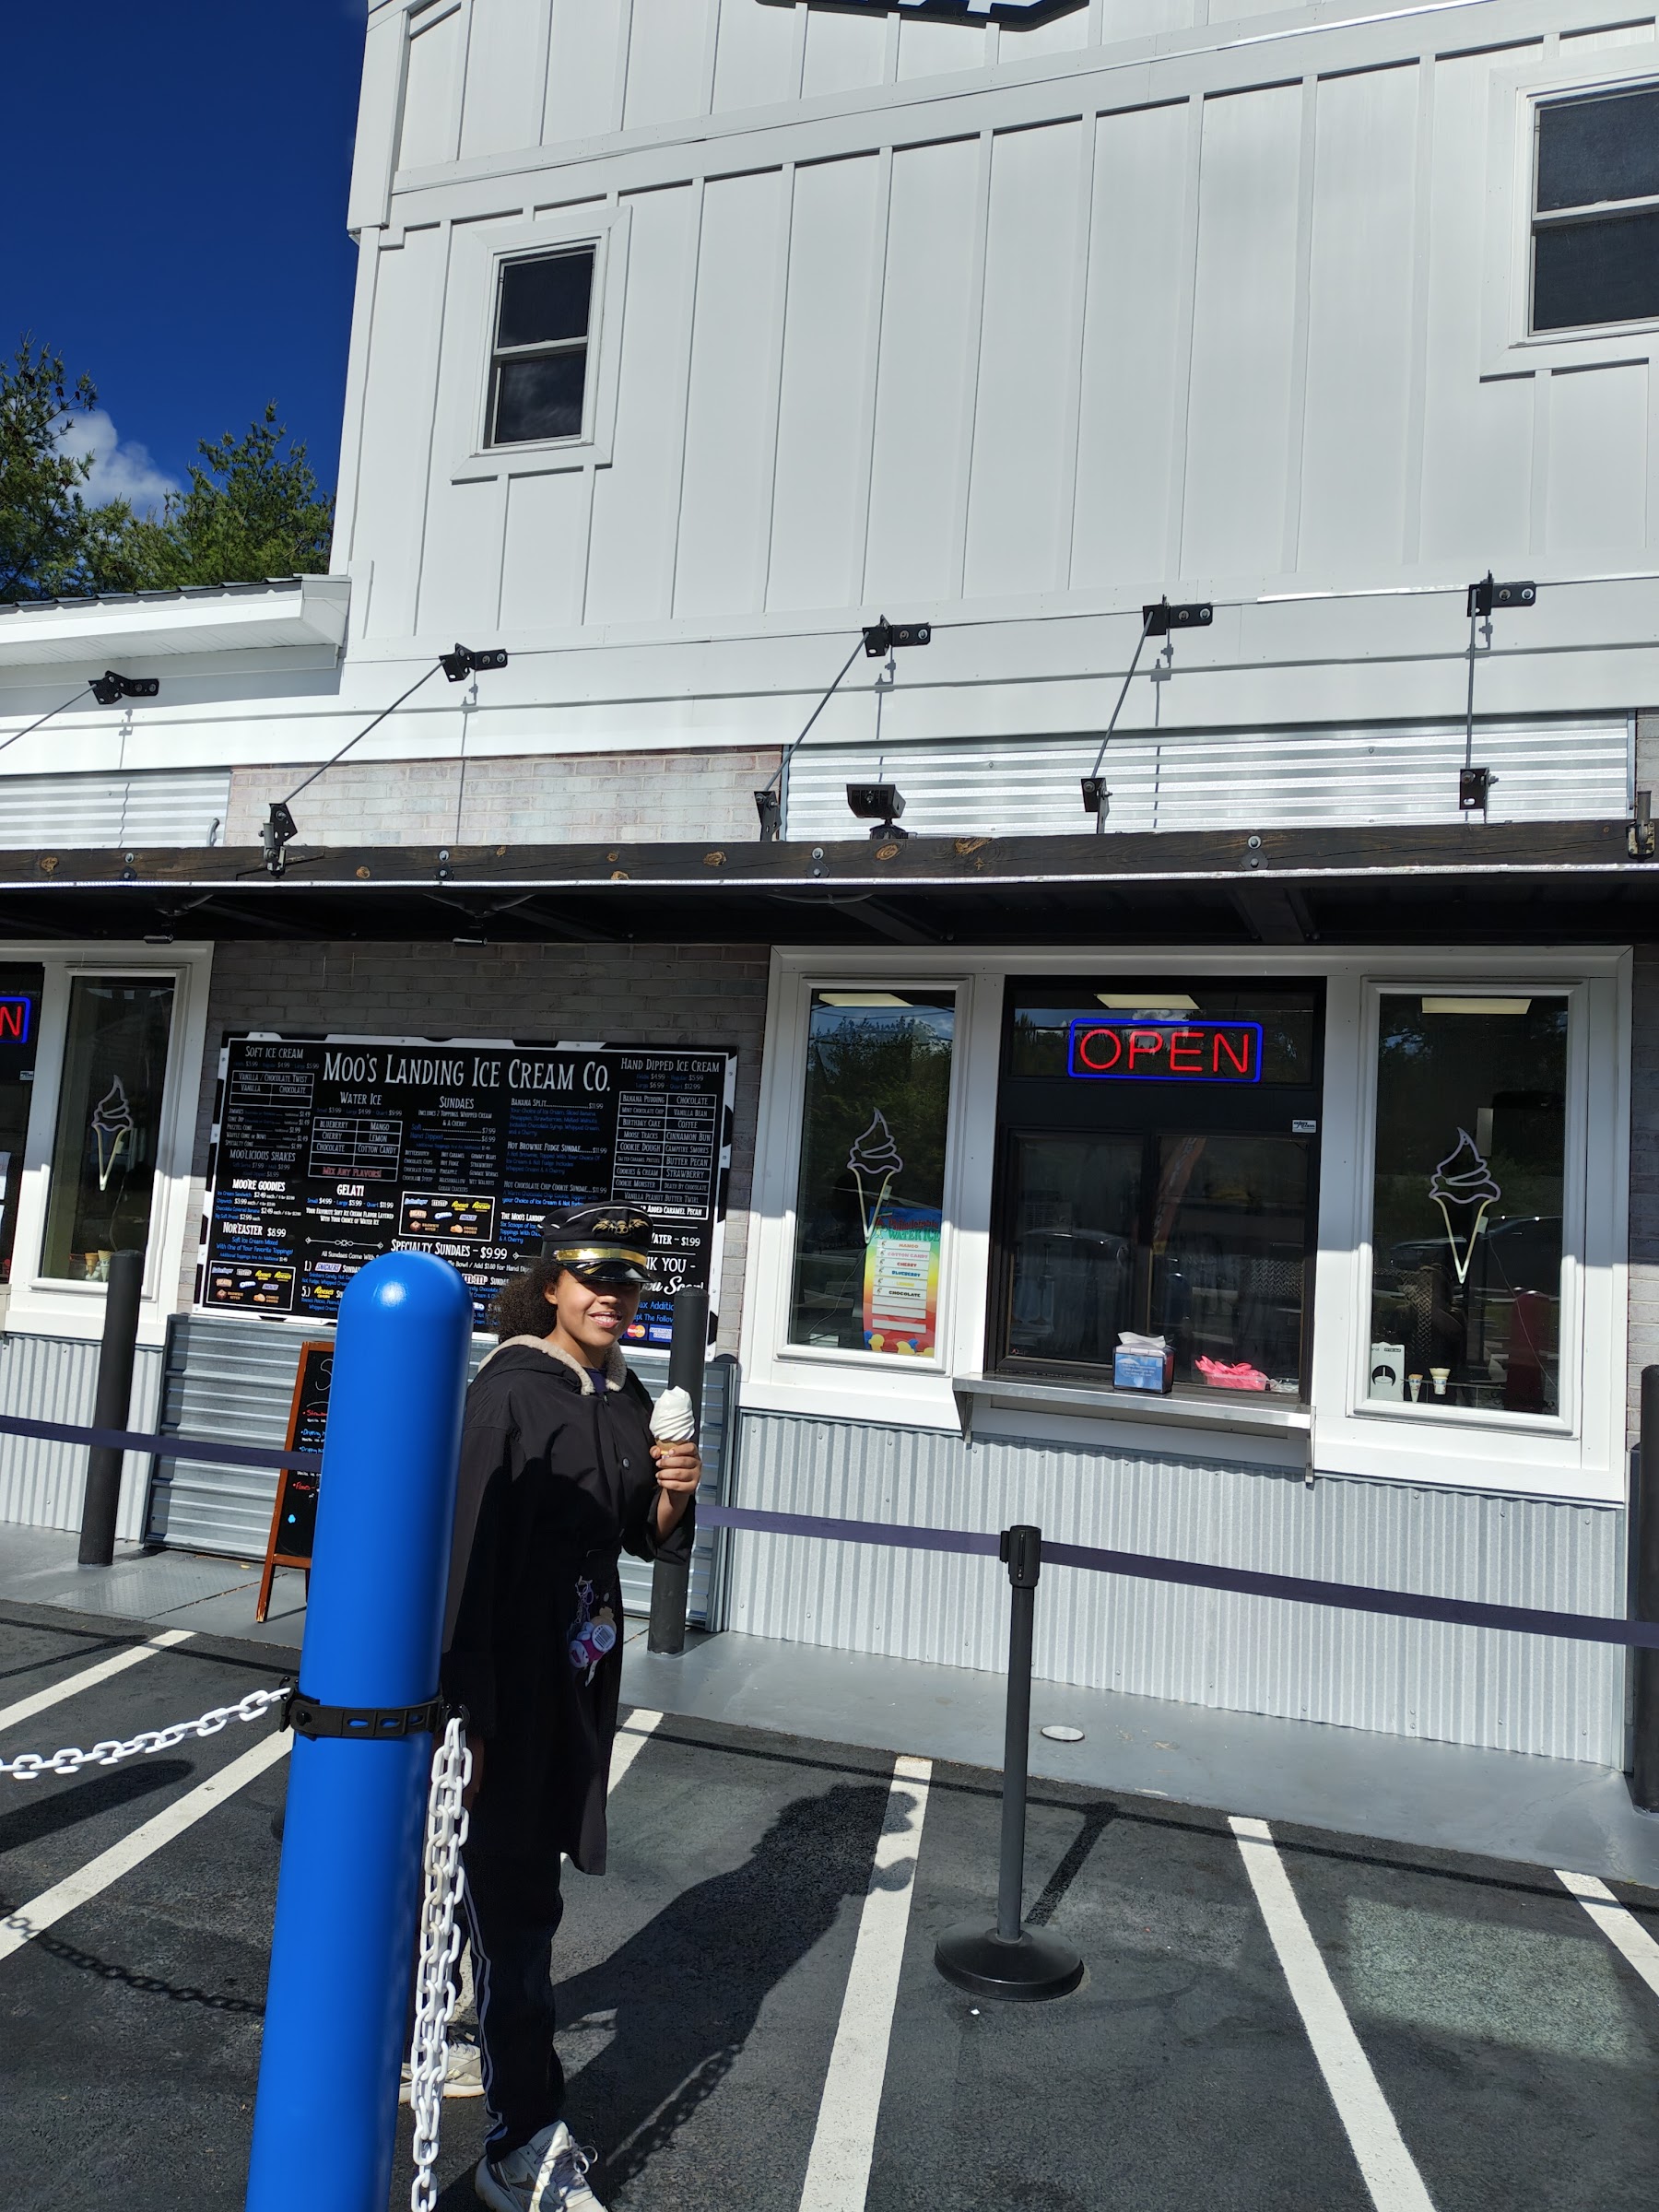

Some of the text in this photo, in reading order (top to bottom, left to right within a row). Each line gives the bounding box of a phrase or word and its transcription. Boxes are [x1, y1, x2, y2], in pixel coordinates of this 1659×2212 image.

[245, 1046, 303, 1059] SOFT ICE CREAM
[1080, 1029, 1249, 1073] OPEN
[621, 1057, 720, 1073] HAND DIPPED ICE CREAM
[323, 1052, 611, 1092] MOO'S LANDING ICE CREAM CO.
[239, 1073, 308, 1083] VANILLA CHOCOLATE TWIST
[241, 1084, 261, 1092] VANILLA
[279, 1086, 306, 1094] CHOCOLATE
[340, 1091, 382, 1105] WATER ICE
[439, 1096, 475, 1109] SUNDAES
[511, 1098, 532, 1106] BANANA
[623, 1094, 665, 1103] BANANA PUDDING
[677, 1096, 709, 1105] CHOCOLATE
[695, 1109, 708, 1117] BEAN
[320, 1120, 348, 1129] BLUEBERRY
[370, 1122, 390, 1131] MANGO
[623, 1118, 661, 1127] BIRTHDAY CAKE
[678, 1120, 698, 1129] COFFEE
[322, 1131, 342, 1140] CHERRY
[369, 1134, 387, 1142] LEMON
[666, 1132, 711, 1142] CINNAMON BUN
[317, 1143, 345, 1152] CHOCOLATE
[358, 1144, 396, 1154] COTTON CANDY
[507, 1141, 518, 1149] HOT
[519, 1142, 543, 1151] BROWNIE
[544, 1143, 559, 1151] FUDGE
[620, 1142, 661, 1152] COOKIE DOUGH
[665, 1145, 688, 1153] CAMPFIRE
[271, 1151, 296, 1161] SHAKES
[666, 1157, 708, 1167] BUTTER PECAN
[322, 1167, 335, 1175] MIX
[617, 1167, 635, 1175] COOKIES
[642, 1168, 658, 1176] CREAM
[666, 1169, 704, 1179] STRAWBERRY
[258, 1181, 286, 1192] GOODIES
[514, 1182, 540, 1190] CHOCOLATE
[616, 1179, 655, 1188] COOKIE MONSTER
[336, 1184, 364, 1196] GELATI
[624, 1192, 643, 1200] VANILLA
[645, 1193, 664, 1201] PEANUT
[500, 1212, 511, 1220] THE
[664, 1206, 685, 1215] CARAMEL
[687, 1207, 702, 1216] PECAN
[222, 1221, 287, 1237] NOR'EASTER $8.99
[888, 1229, 940, 1241] WATER ICE
[681, 1237, 701, 1247] $1.99
[391, 1239, 508, 1260] SPECIALTY SUNDAES $9.99
[662, 1257, 687, 1273] YOU
[651, 1301, 674, 1311] Additi
